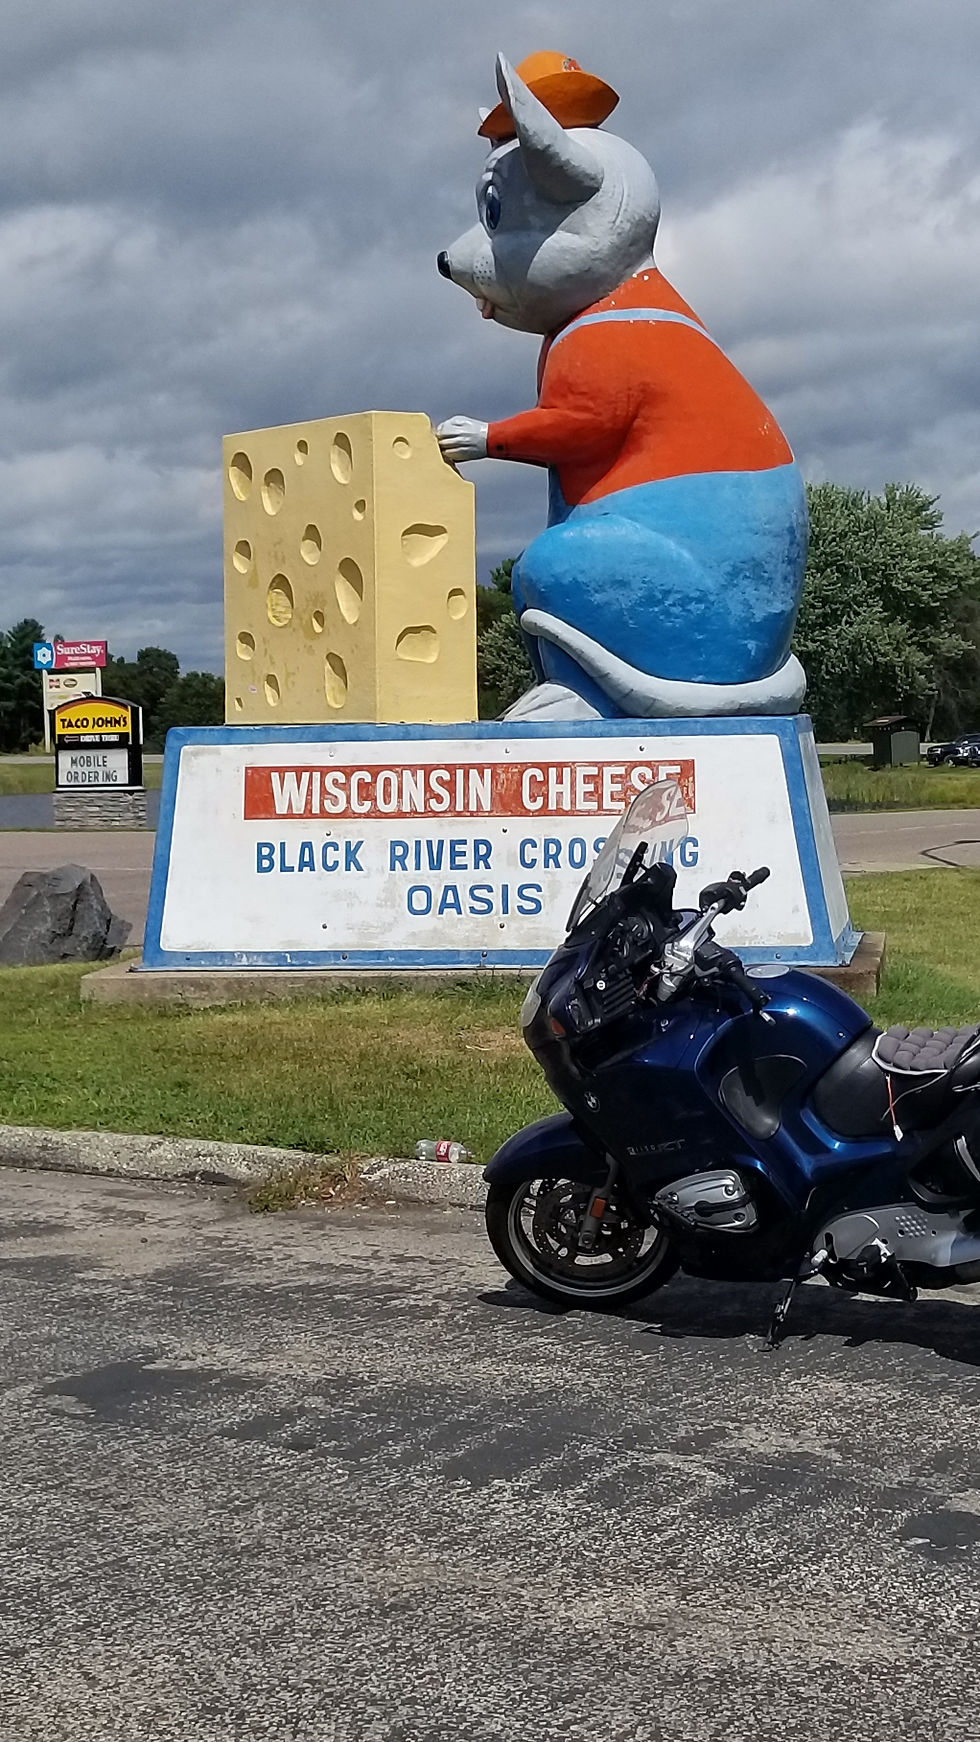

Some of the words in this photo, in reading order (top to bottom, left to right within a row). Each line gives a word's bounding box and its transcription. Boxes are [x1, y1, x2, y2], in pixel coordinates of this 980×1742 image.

[57, 643, 102, 658] SureStay
[60, 717, 90, 729] TACO
[92, 714, 128, 729] JOHN'S
[70, 755, 108, 768] MOBILE
[66, 770, 118, 783] ORDERING
[271, 768, 492, 815] WISCONSIN
[256, 840, 364, 874] BLACK
[389, 838, 493, 872] RIVER
[519, 836, 699, 870] CROSING
[407, 883, 543, 916] OASIS
